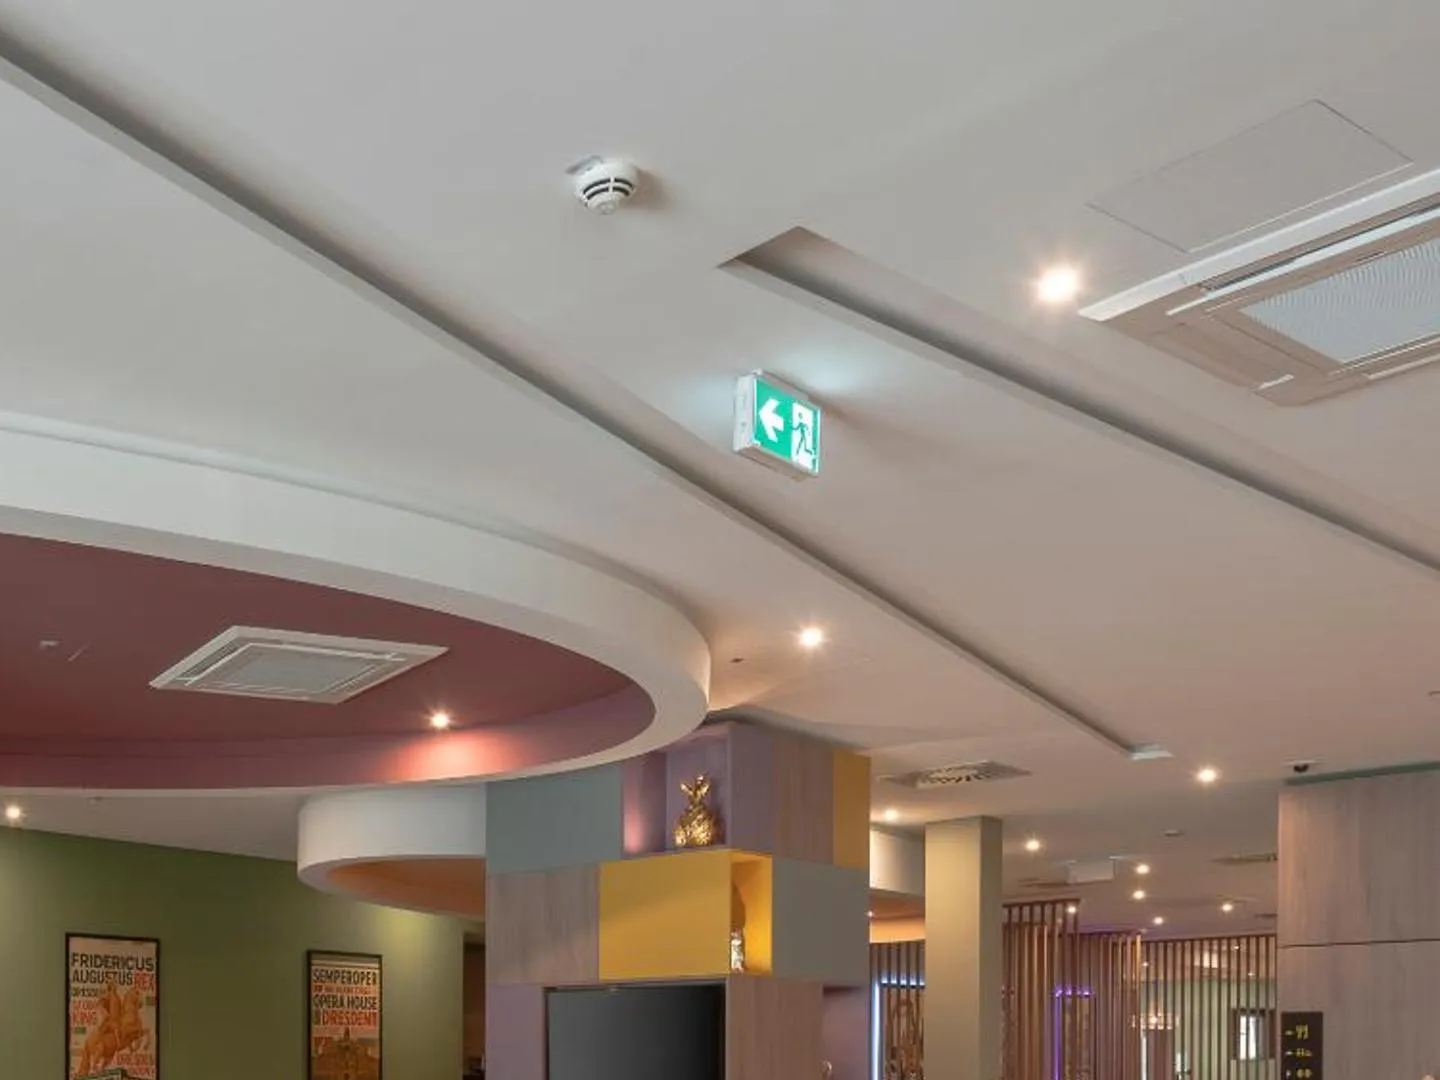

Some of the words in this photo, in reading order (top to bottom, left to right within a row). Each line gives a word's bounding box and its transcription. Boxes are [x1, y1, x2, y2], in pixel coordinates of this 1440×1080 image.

[71, 952, 155, 972] FRIDERICUS
[72, 969, 134, 986] AUGUSTUS
[313, 968, 377, 986] SEMPEROPER
[313, 993, 344, 1009] OPERA
[346, 995, 378, 1010] HOUSE
[322, 1009, 377, 1026] DRESDEN
